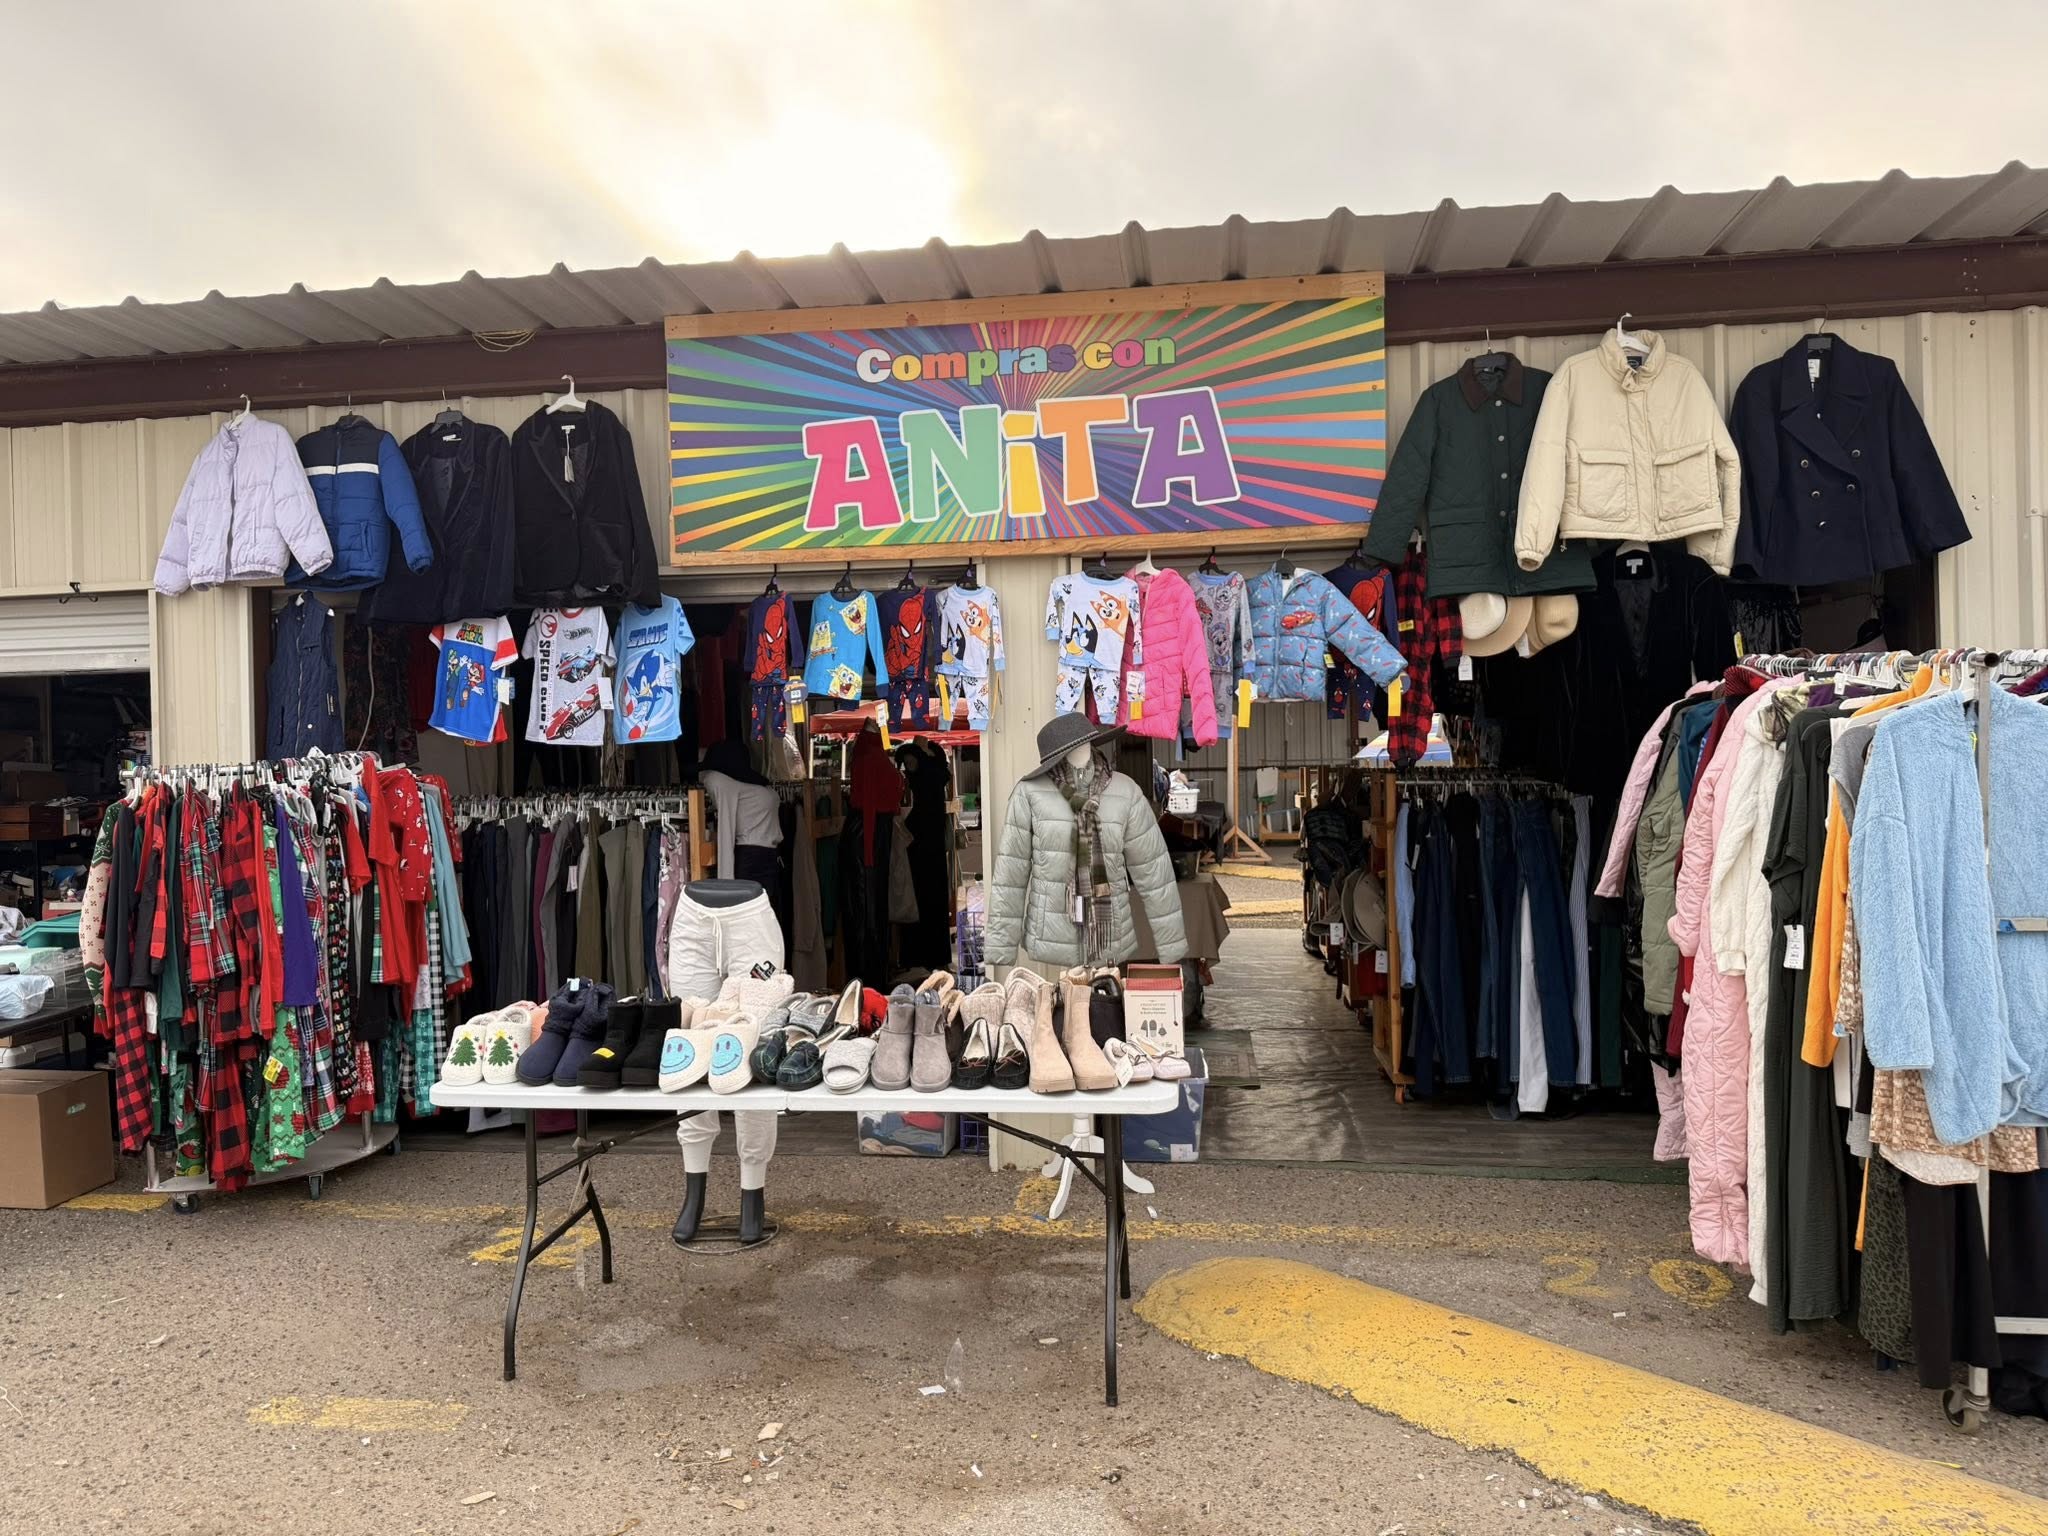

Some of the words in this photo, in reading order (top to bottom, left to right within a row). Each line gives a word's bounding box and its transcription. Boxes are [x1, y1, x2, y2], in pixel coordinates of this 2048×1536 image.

[855, 343, 1077, 387] Compras
[1082, 336, 1177, 371] con
[456, 629, 484, 645] MARIO
[539, 640, 551, 682] SPEED
[540, 687, 548, 723] CLUB
